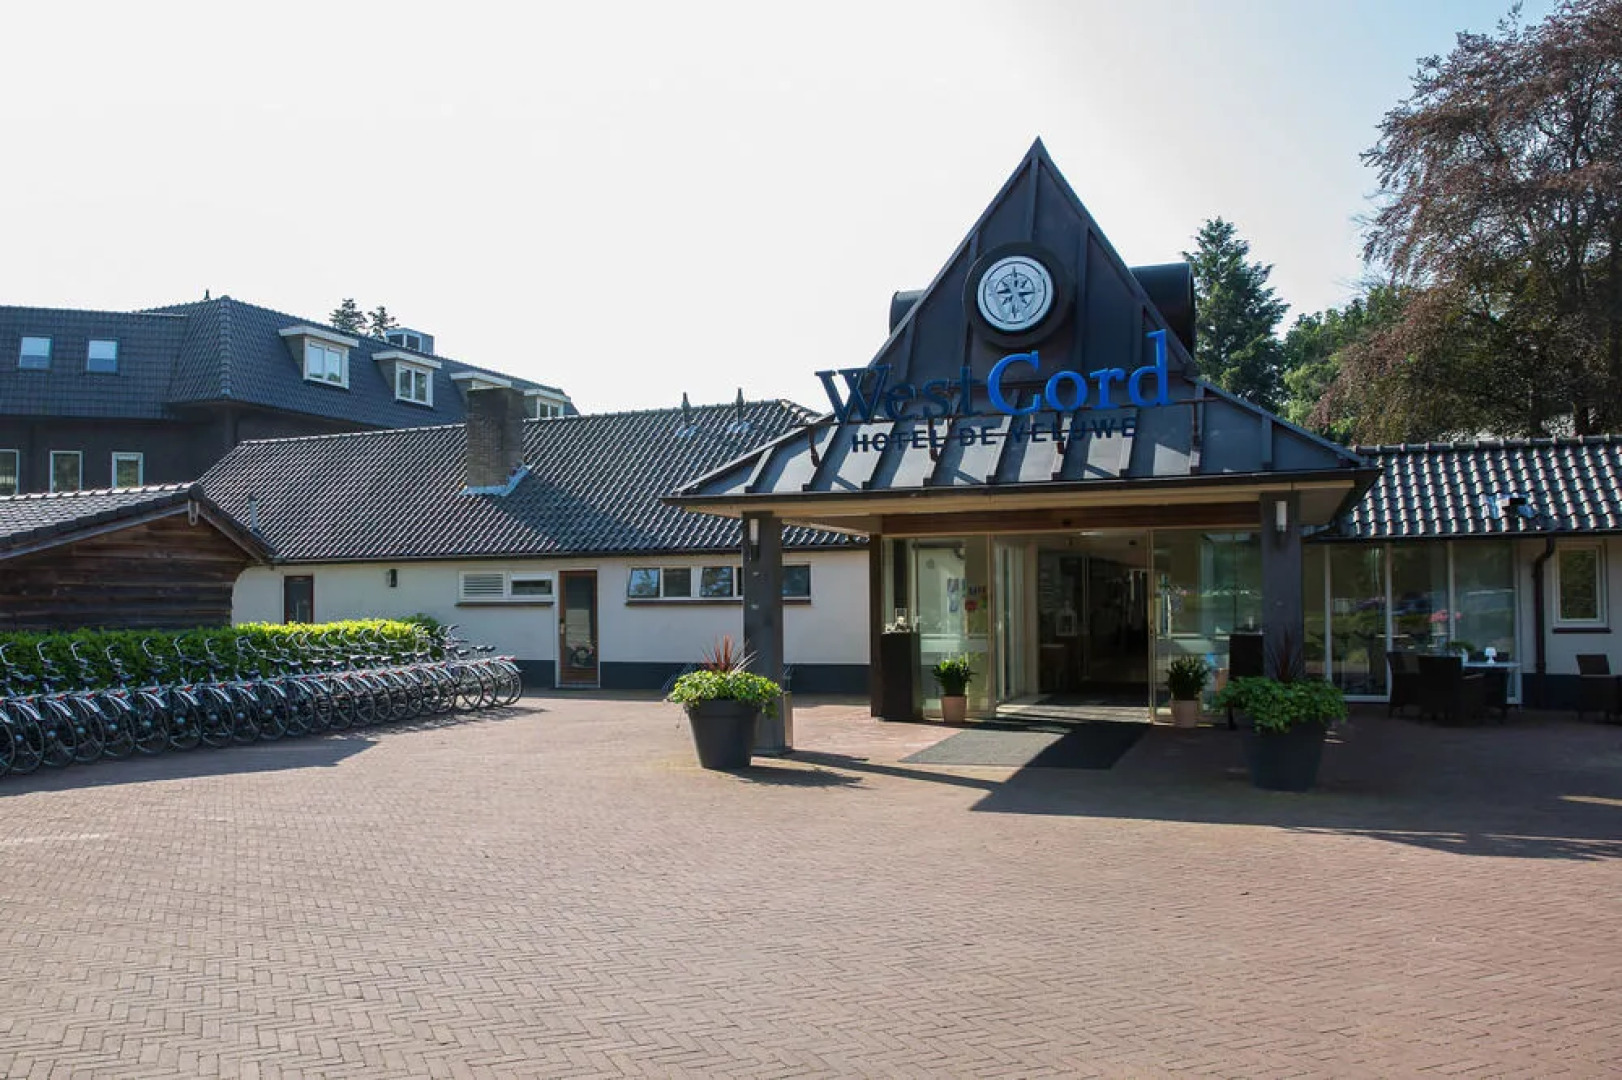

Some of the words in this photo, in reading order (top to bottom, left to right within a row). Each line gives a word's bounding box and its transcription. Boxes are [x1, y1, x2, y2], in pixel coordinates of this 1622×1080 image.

[814, 328, 1172, 424] WestCord
[852, 429, 945, 453] HOTEL
[959, 427, 997, 447] DE
[1010, 416, 1137, 442] VELUWE
